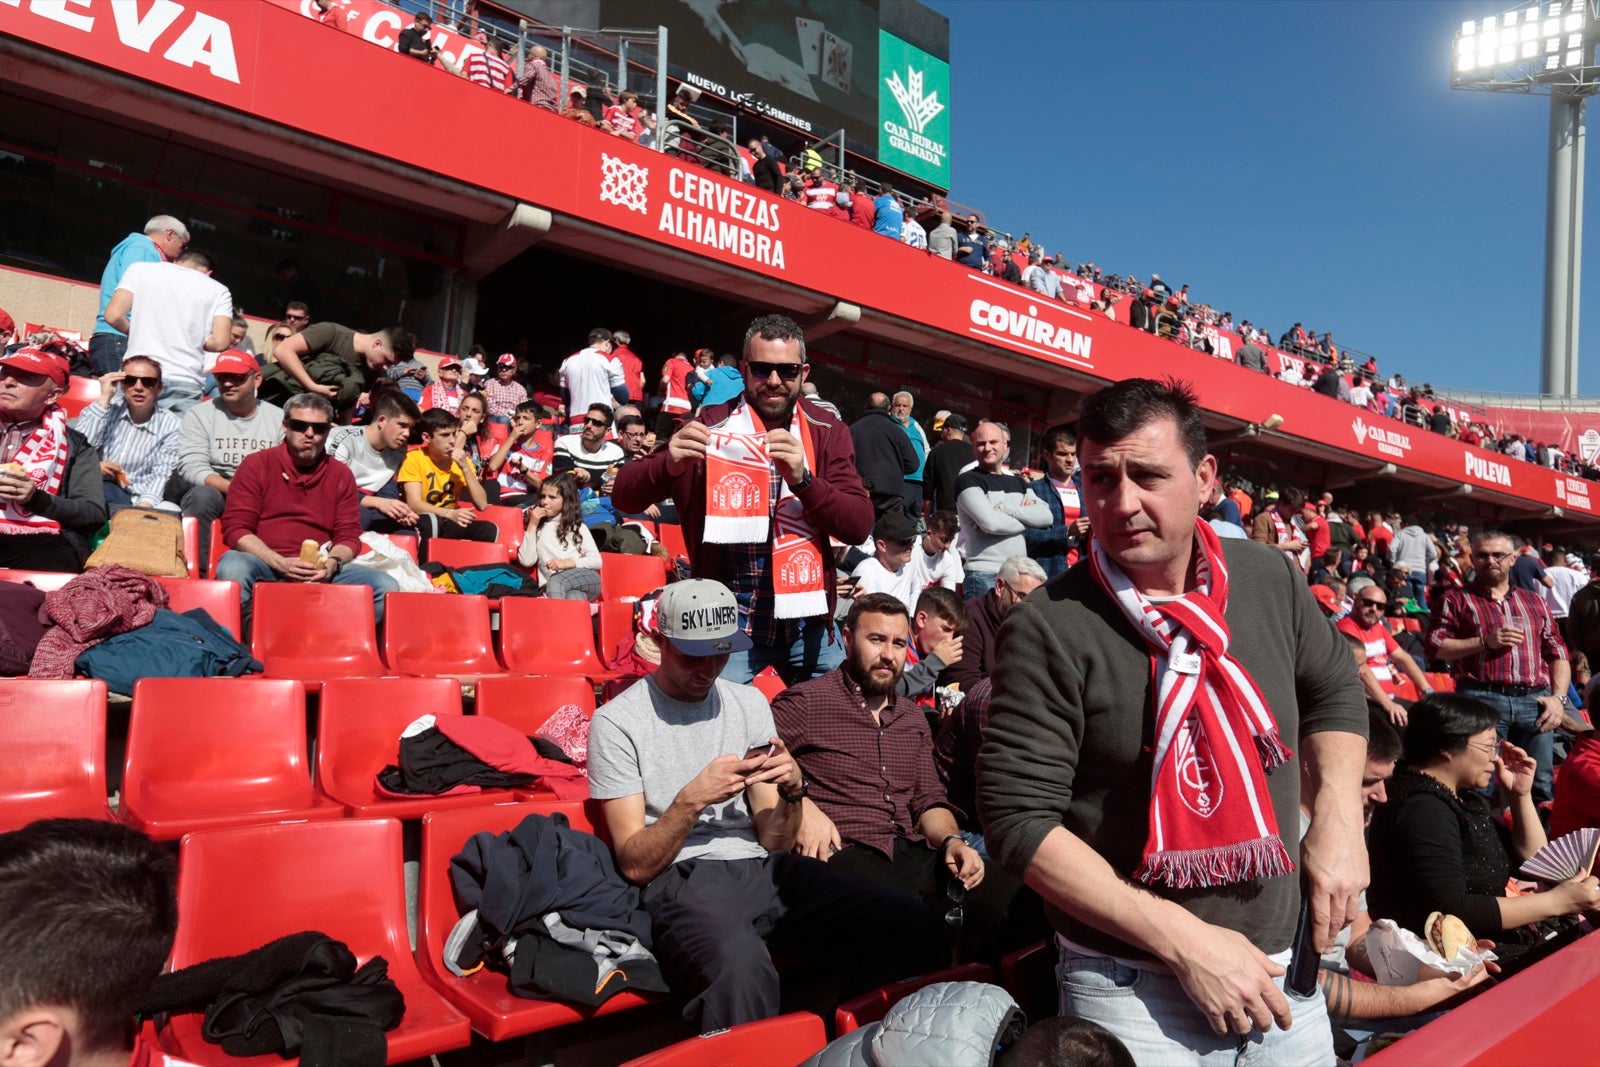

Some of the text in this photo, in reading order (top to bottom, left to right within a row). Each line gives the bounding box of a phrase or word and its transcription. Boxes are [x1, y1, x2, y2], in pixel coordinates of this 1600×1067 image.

[0, 0, 241, 84] EVA
[687, 72, 726, 95] NUEVO
[884, 121, 946, 157] CAJA RURAL
[889, 135, 941, 166] GRANADA
[669, 168, 780, 231] CERVEZAS
[658, 202, 785, 269] ALHAMBRA
[1464, 451, 1512, 487] PULEVA
[681, 606, 737, 630] SKYLINERS
